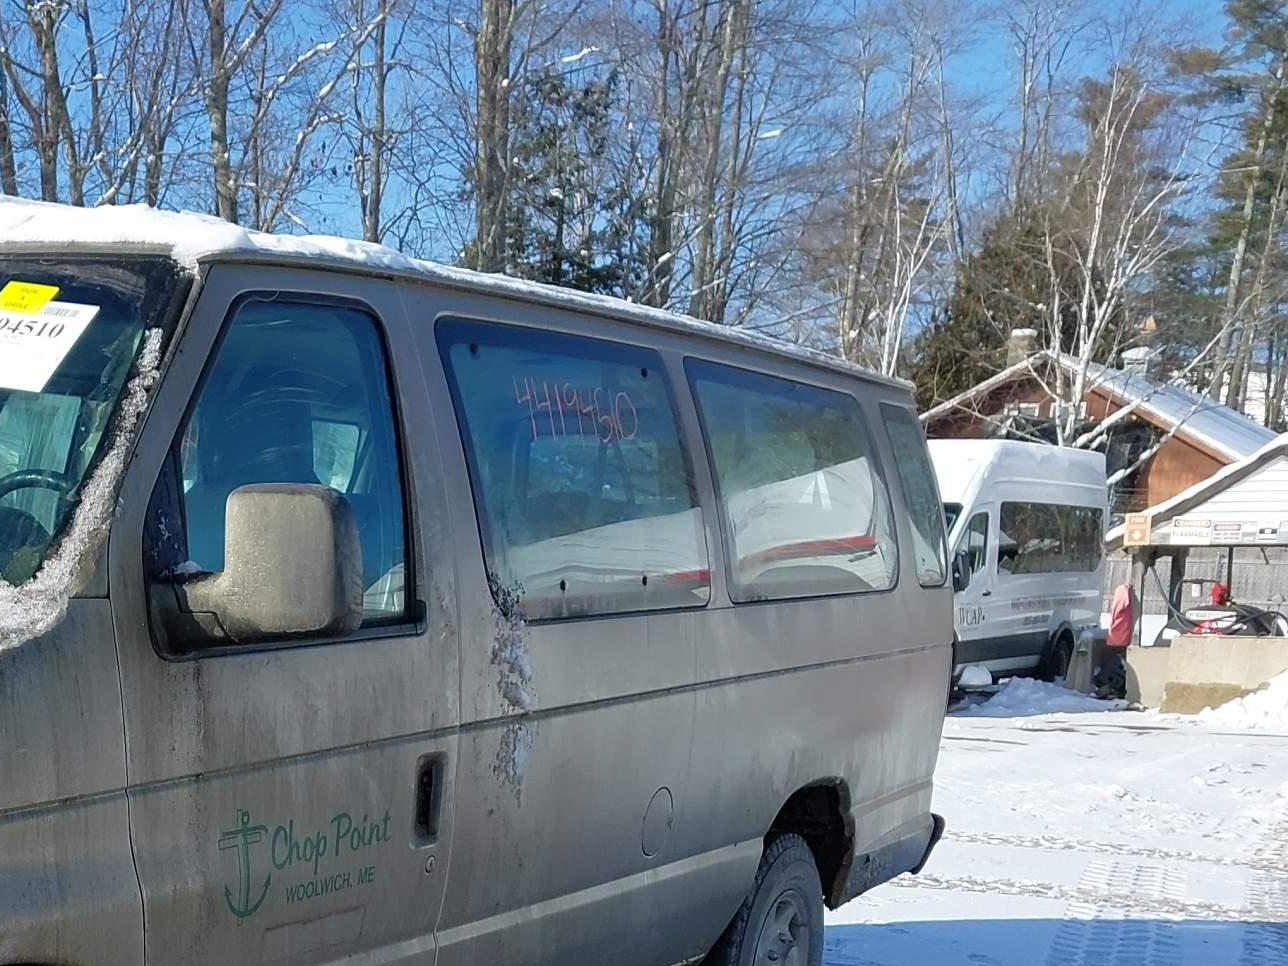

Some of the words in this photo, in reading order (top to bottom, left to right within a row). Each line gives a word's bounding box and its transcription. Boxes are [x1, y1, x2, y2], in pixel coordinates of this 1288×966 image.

[272, 818, 328, 876] Chop
[330, 810, 391, 856] Point
[357, 865, 375, 885] ME
